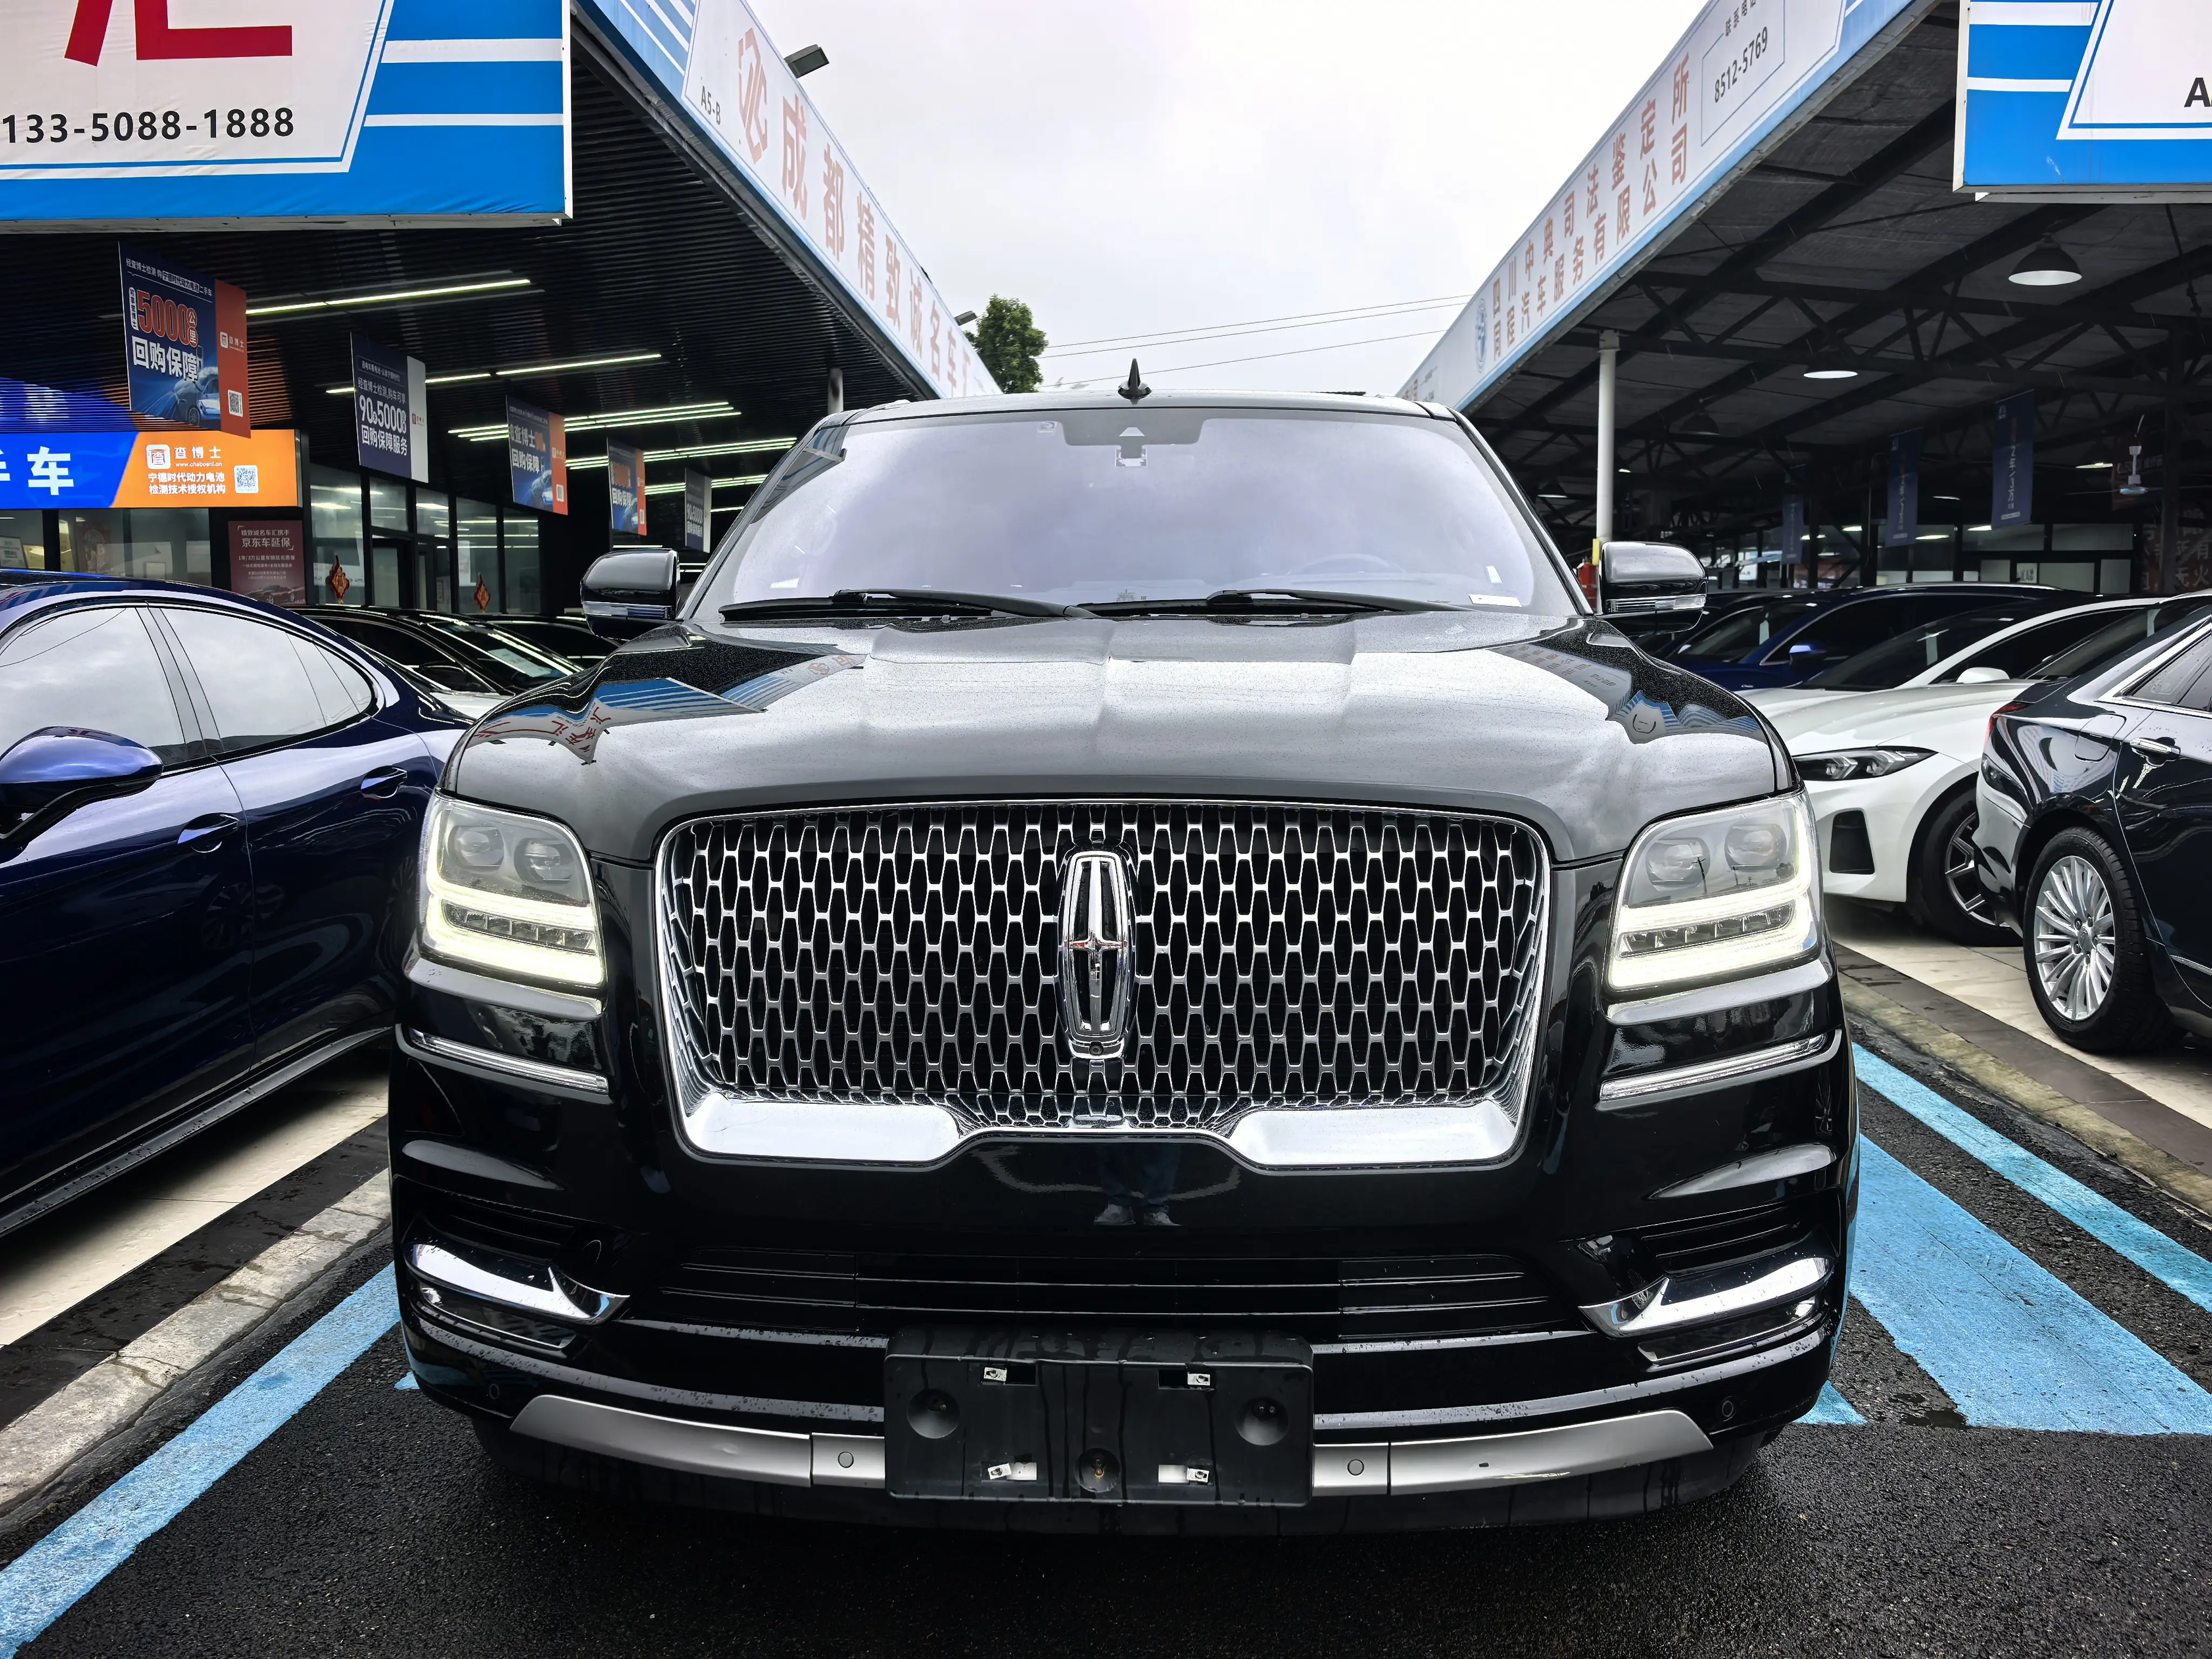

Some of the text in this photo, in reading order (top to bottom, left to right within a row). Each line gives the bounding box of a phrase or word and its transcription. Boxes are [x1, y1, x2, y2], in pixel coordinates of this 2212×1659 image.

[1715, 26, 1768, 103] 8512-5769
[701, 85, 720, 125] A5-B
[2184, 77, 2212, 107] A
[2, 107, 294, 144] 133-5088-1888
[132, 335, 198, 382] 回购保障
[174, 446, 221, 459] 查博士
[361, 424, 407, 456] 回购保障服务
[0, 446, 74, 495] 车
[148, 471, 225, 483] 宁德时代动力电池
[149, 484, 226, 495] 检测技术授权机构
[242, 537, 291, 548] 京东车延保
